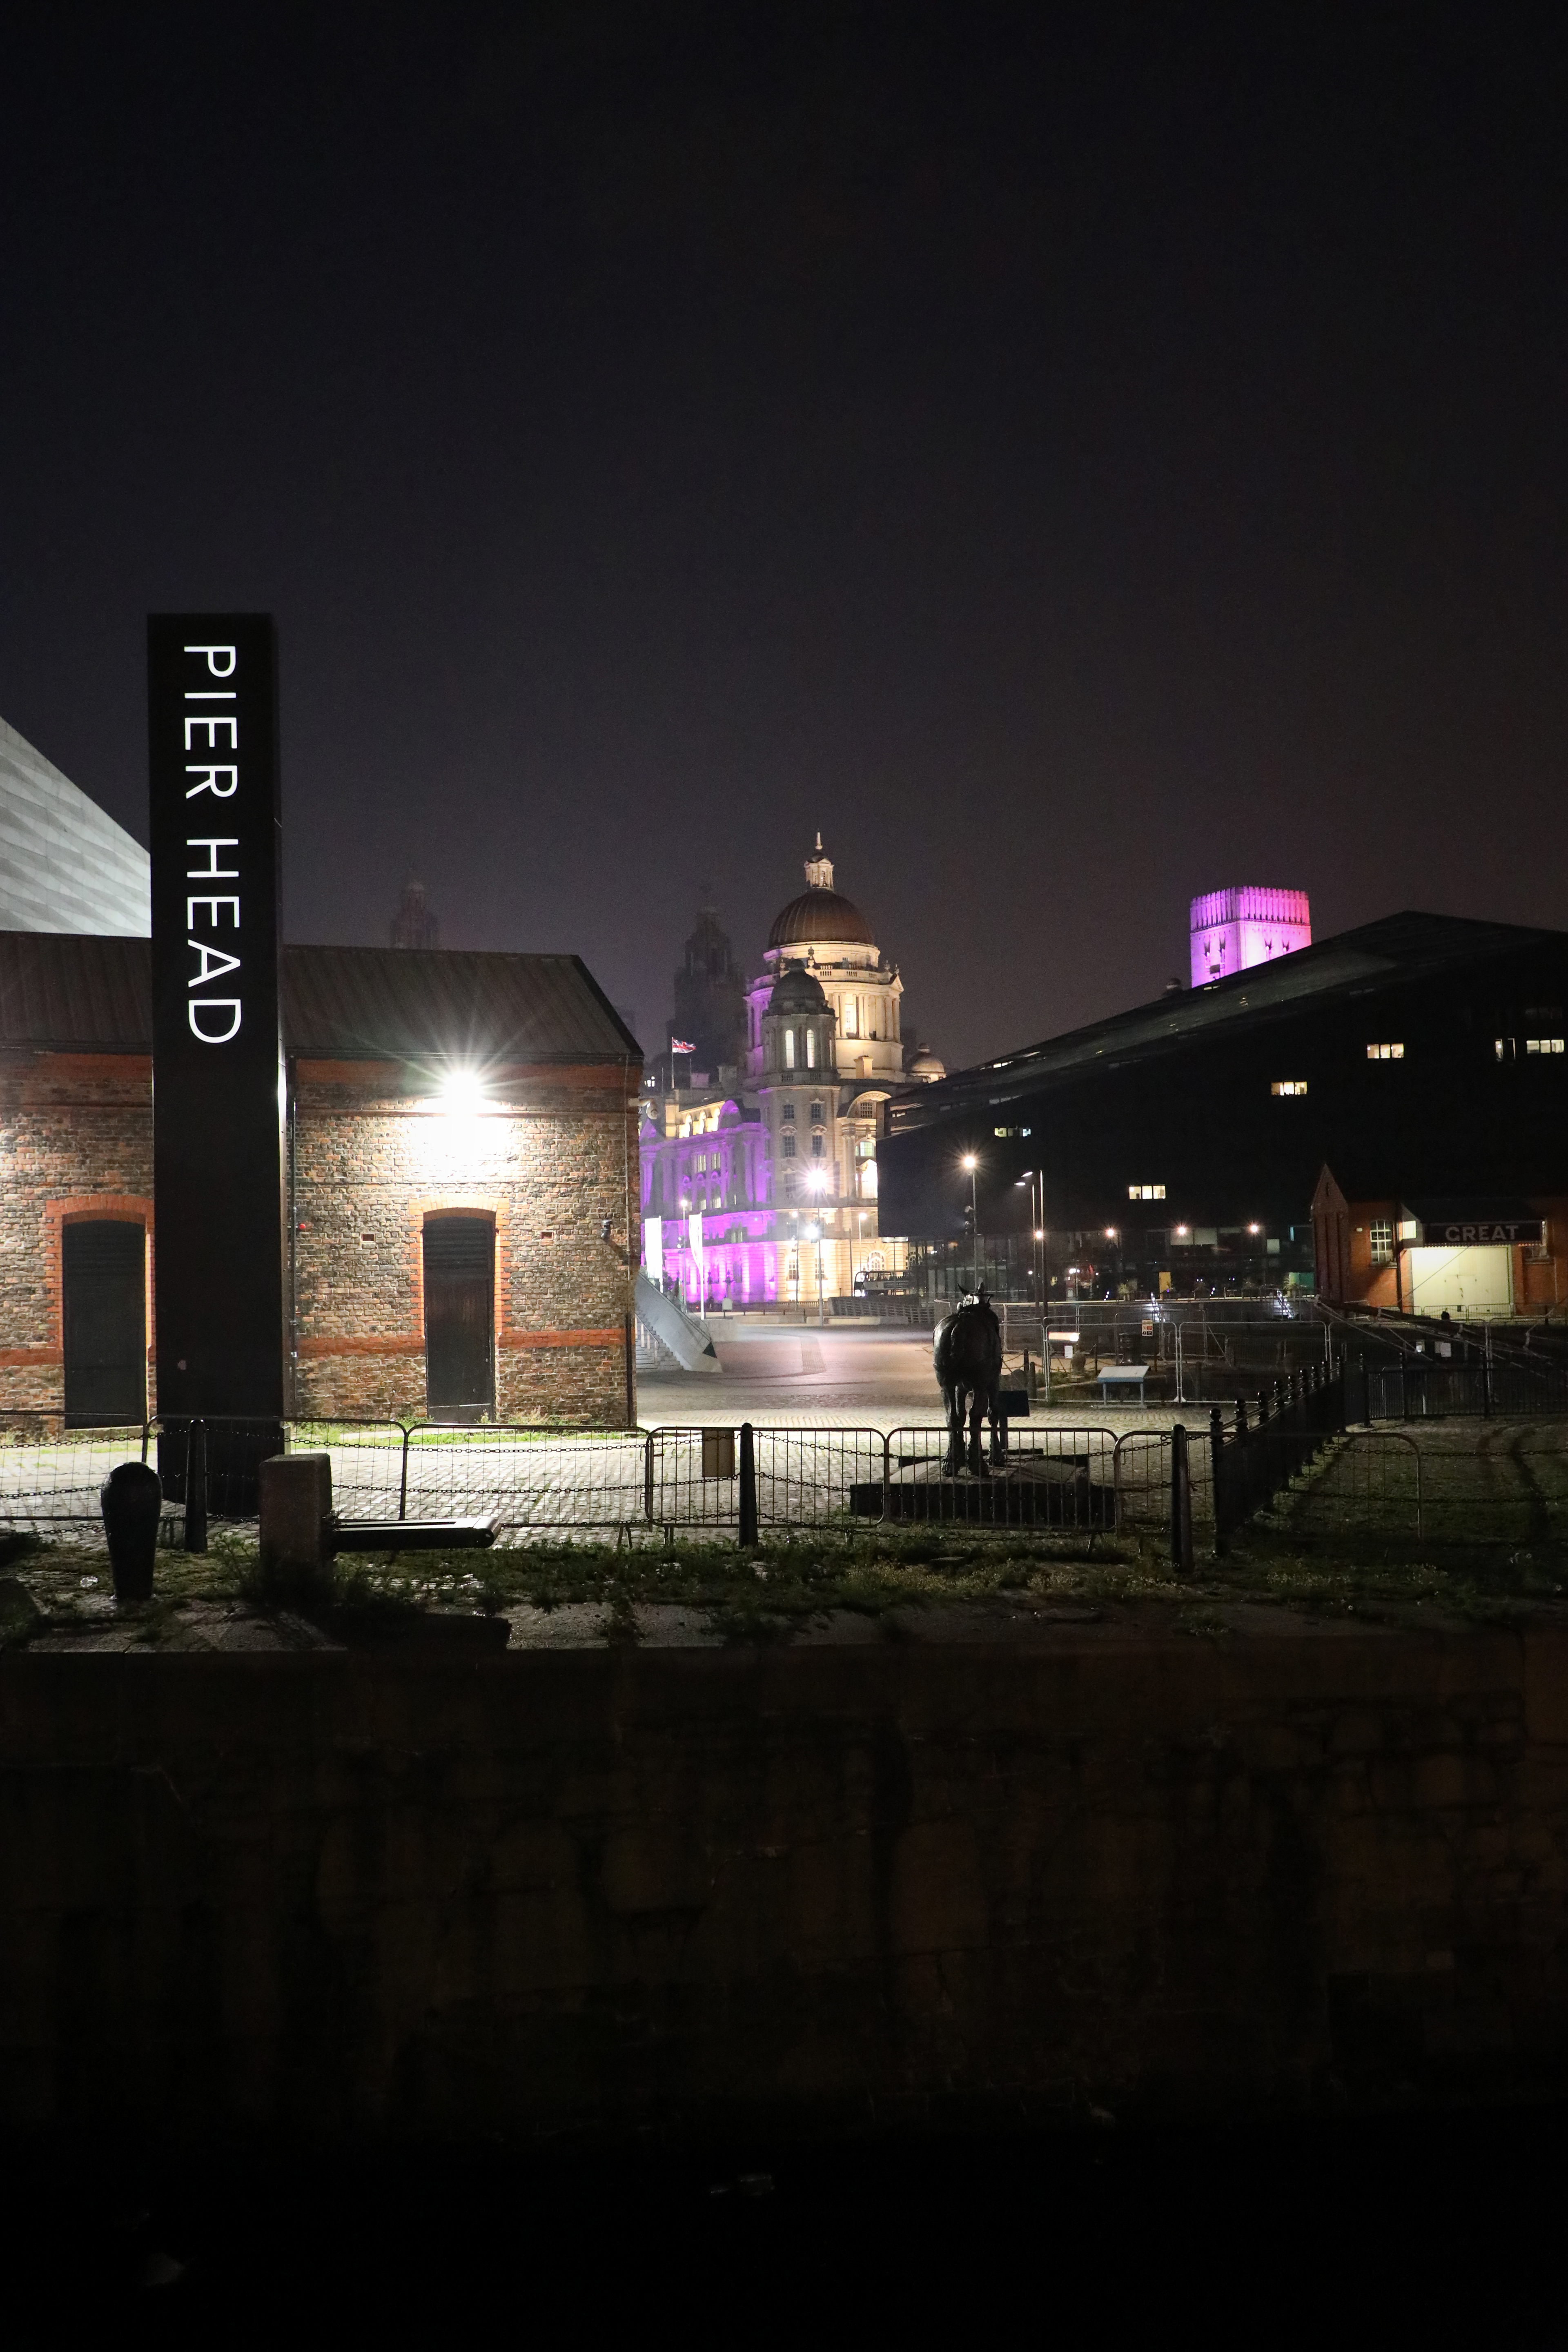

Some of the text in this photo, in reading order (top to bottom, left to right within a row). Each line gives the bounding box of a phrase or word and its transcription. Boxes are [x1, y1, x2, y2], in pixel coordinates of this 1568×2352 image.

[184, 646, 241, 1043] PIER HEAD
[1445, 1225, 1519, 1242] GREAT
